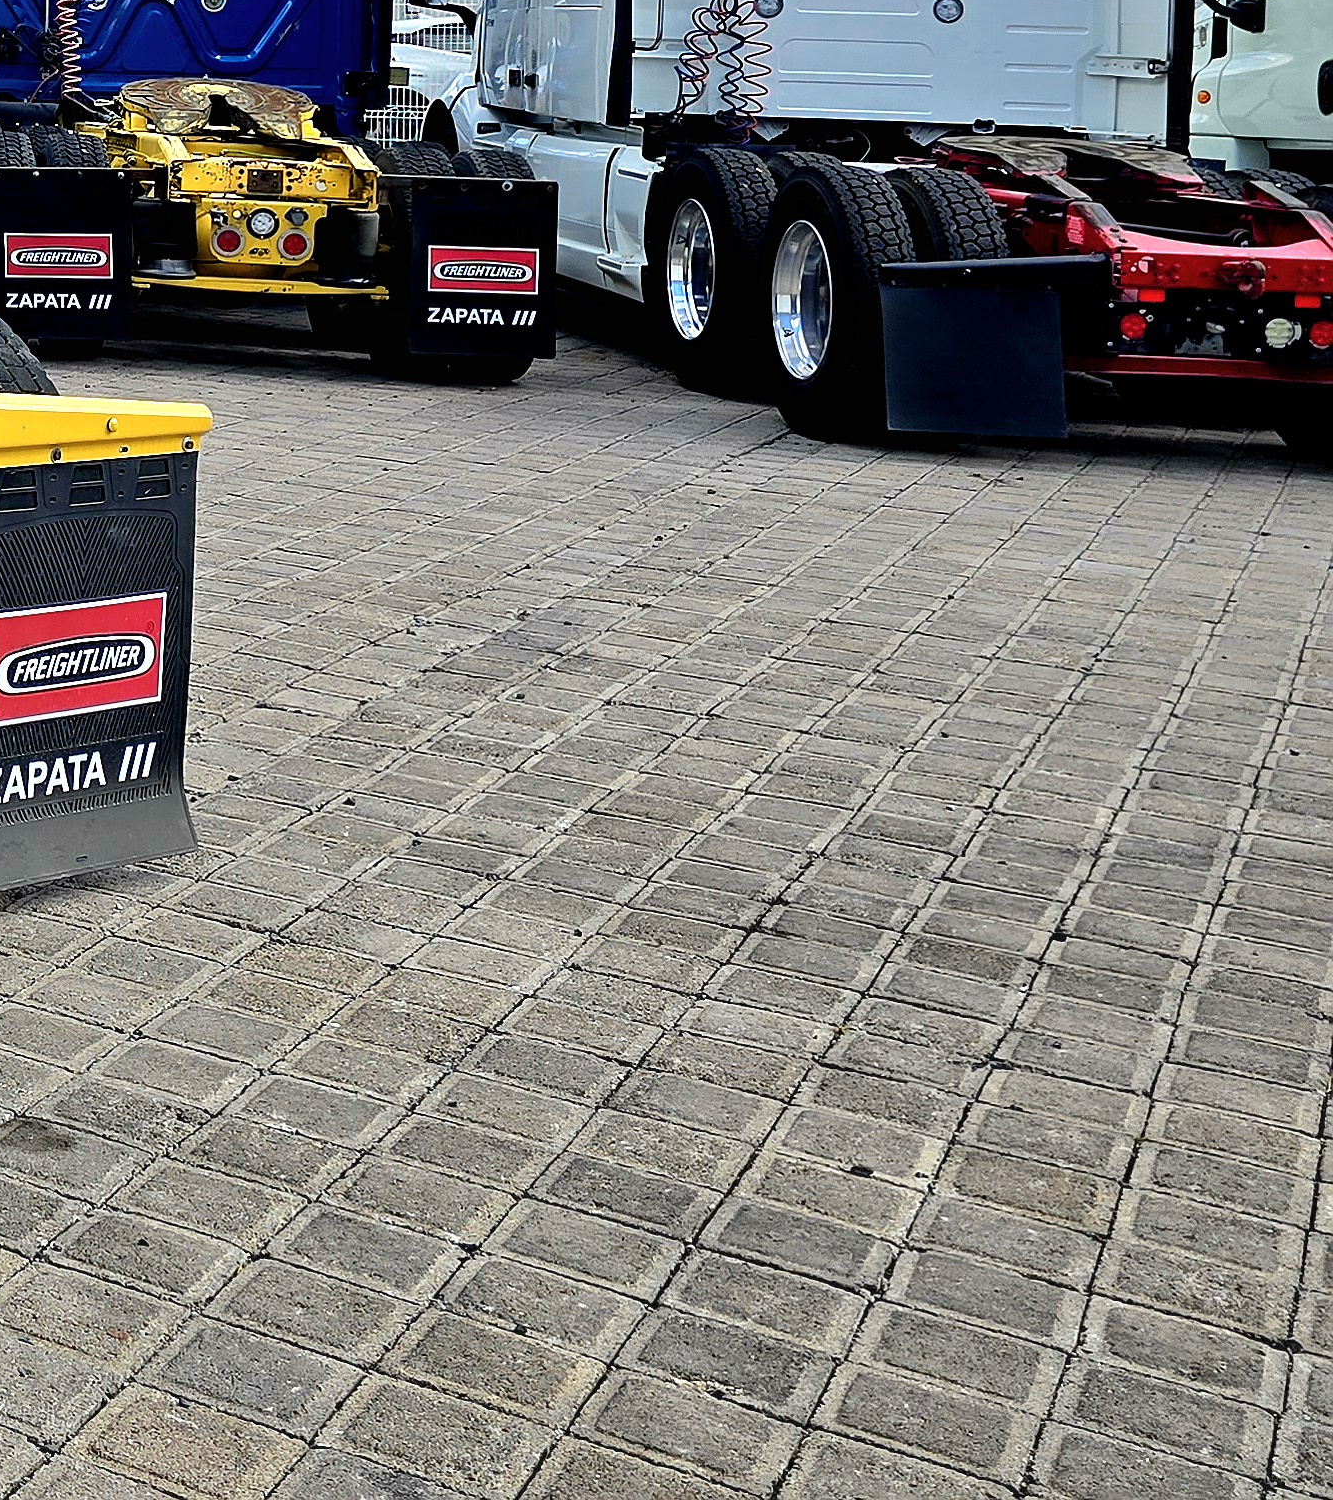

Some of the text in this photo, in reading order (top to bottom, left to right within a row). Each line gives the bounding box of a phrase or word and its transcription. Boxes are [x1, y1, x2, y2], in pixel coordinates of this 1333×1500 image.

[19, 251, 98, 263] FREIGHTLINER
[443, 265, 524, 278] FREIGHTLINER
[5, 292, 82, 309] ZAPATA
[427, 307, 505, 326] ZAPATA
[12, 645, 141, 684] FREIGHTLINER
